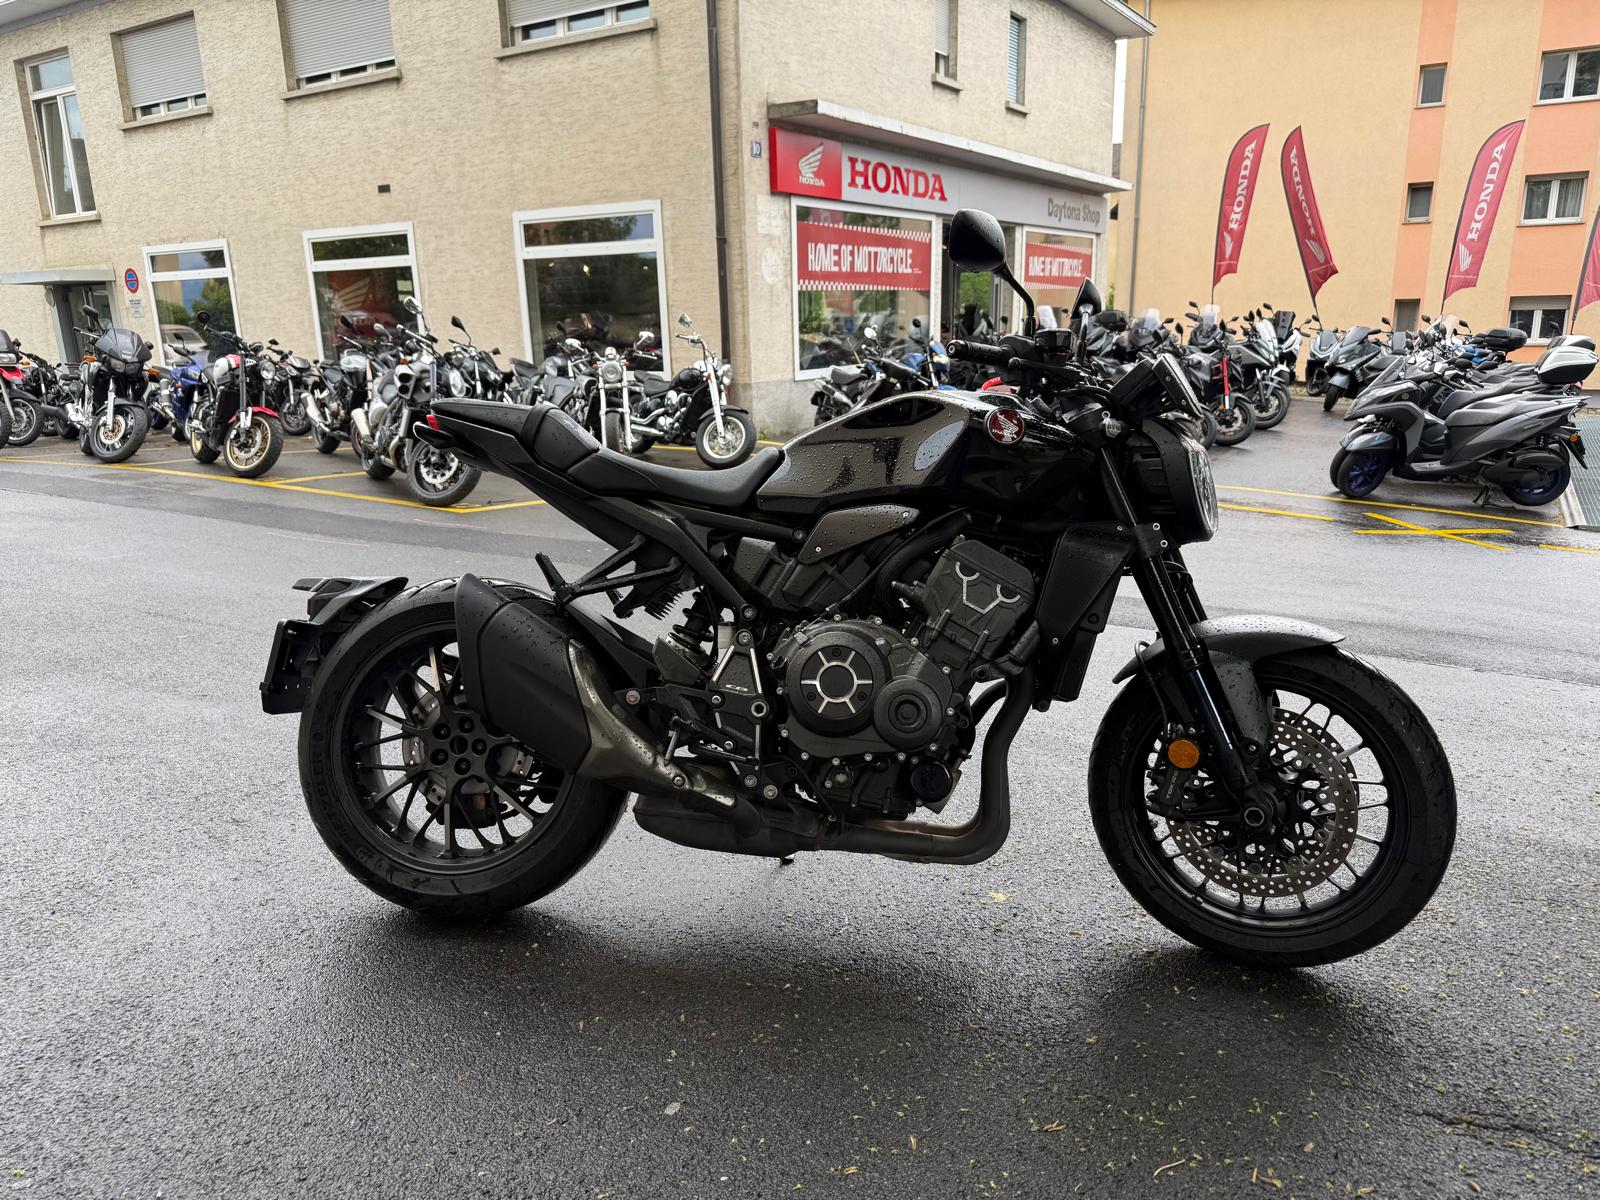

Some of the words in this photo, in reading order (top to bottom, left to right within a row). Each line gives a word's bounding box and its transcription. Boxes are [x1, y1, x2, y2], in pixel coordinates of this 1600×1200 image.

[752, 142, 760, 155] 10
[799, 176, 825, 187] HONDA
[847, 156, 948, 202] HONDA
[1228, 140, 1257, 231] HONDA
[1466, 139, 1507, 242] HONDA
[1048, 198, 1080, 222] Daytona
[1082, 203, 1100, 226] Shop
[807, 242, 839, 272] HOME
[841, 244, 853, 272] OF
